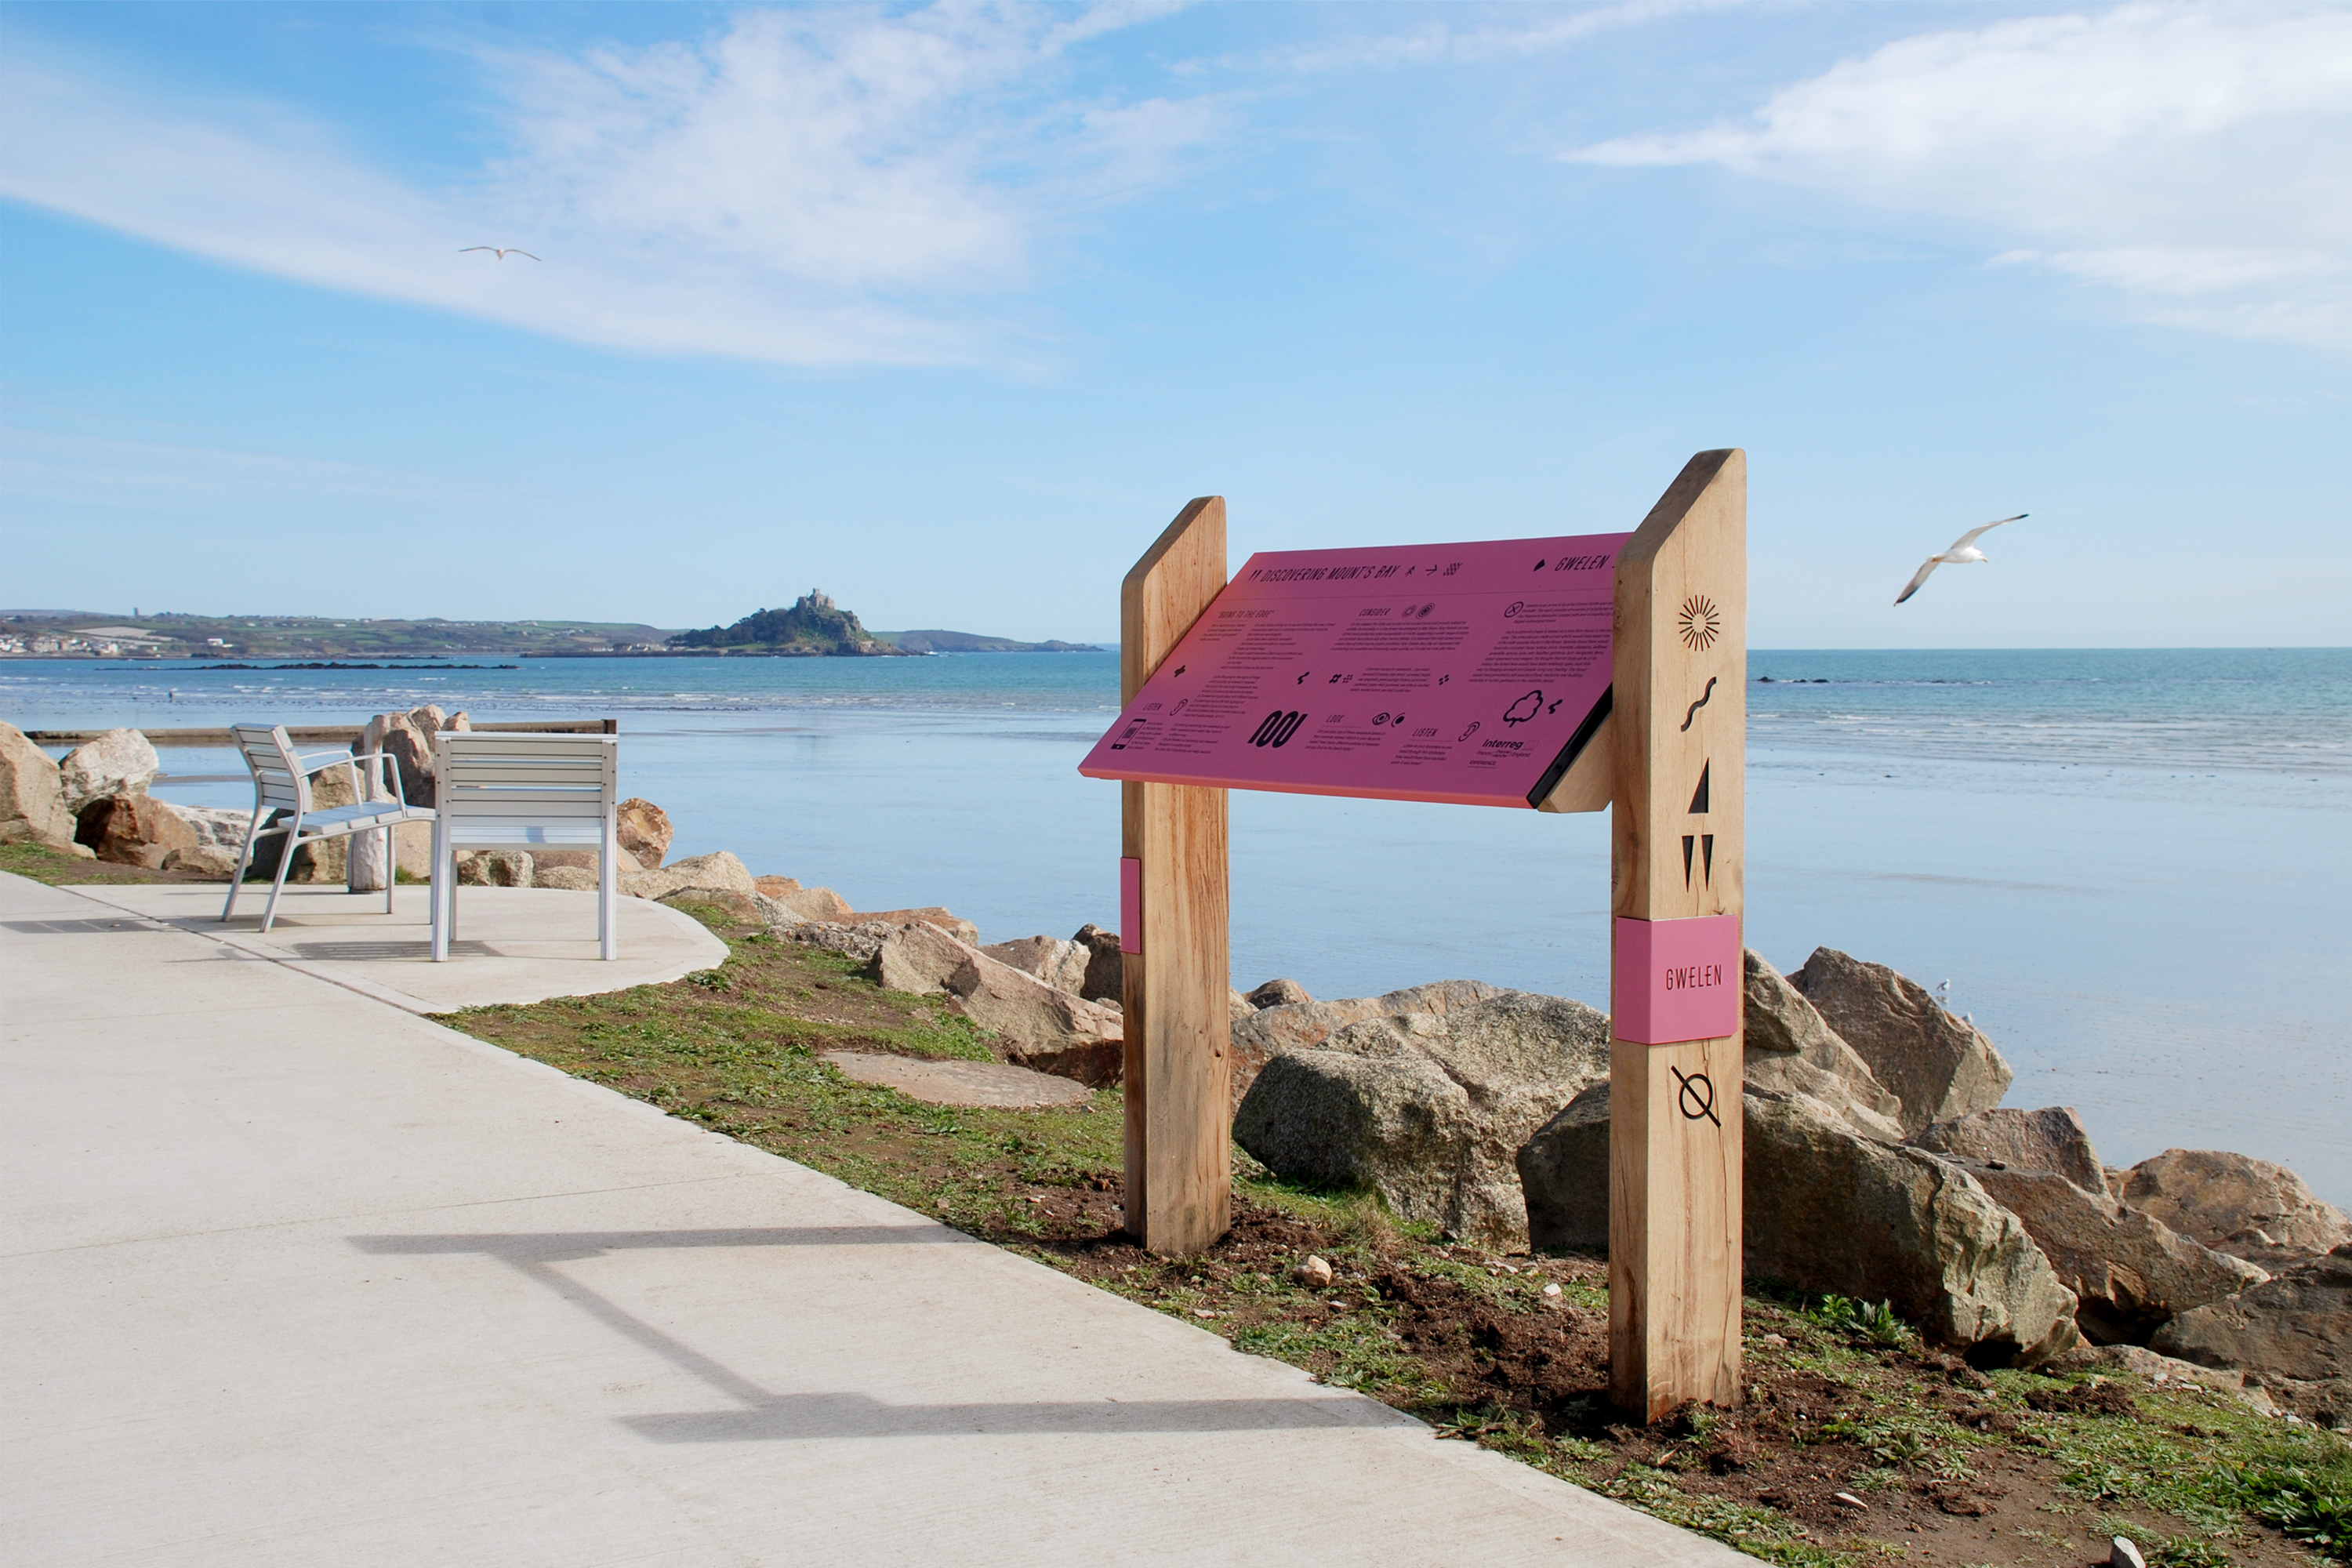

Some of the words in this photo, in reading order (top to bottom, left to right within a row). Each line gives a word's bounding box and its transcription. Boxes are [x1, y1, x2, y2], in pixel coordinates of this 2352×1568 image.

[1555, 555, 1610, 571] GWELEN
[1261, 568, 1328, 582] DISCOVERING
[1327, 566, 1375, 579] MOUNT'S
[1374, 565, 1400, 578] BAY
[1326, 714, 1345, 723] LOOK
[1413, 728, 1438, 737] LISTEN
[1483, 739, 1523, 750] Interreg
[1666, 964, 1722, 991] GWELEN
